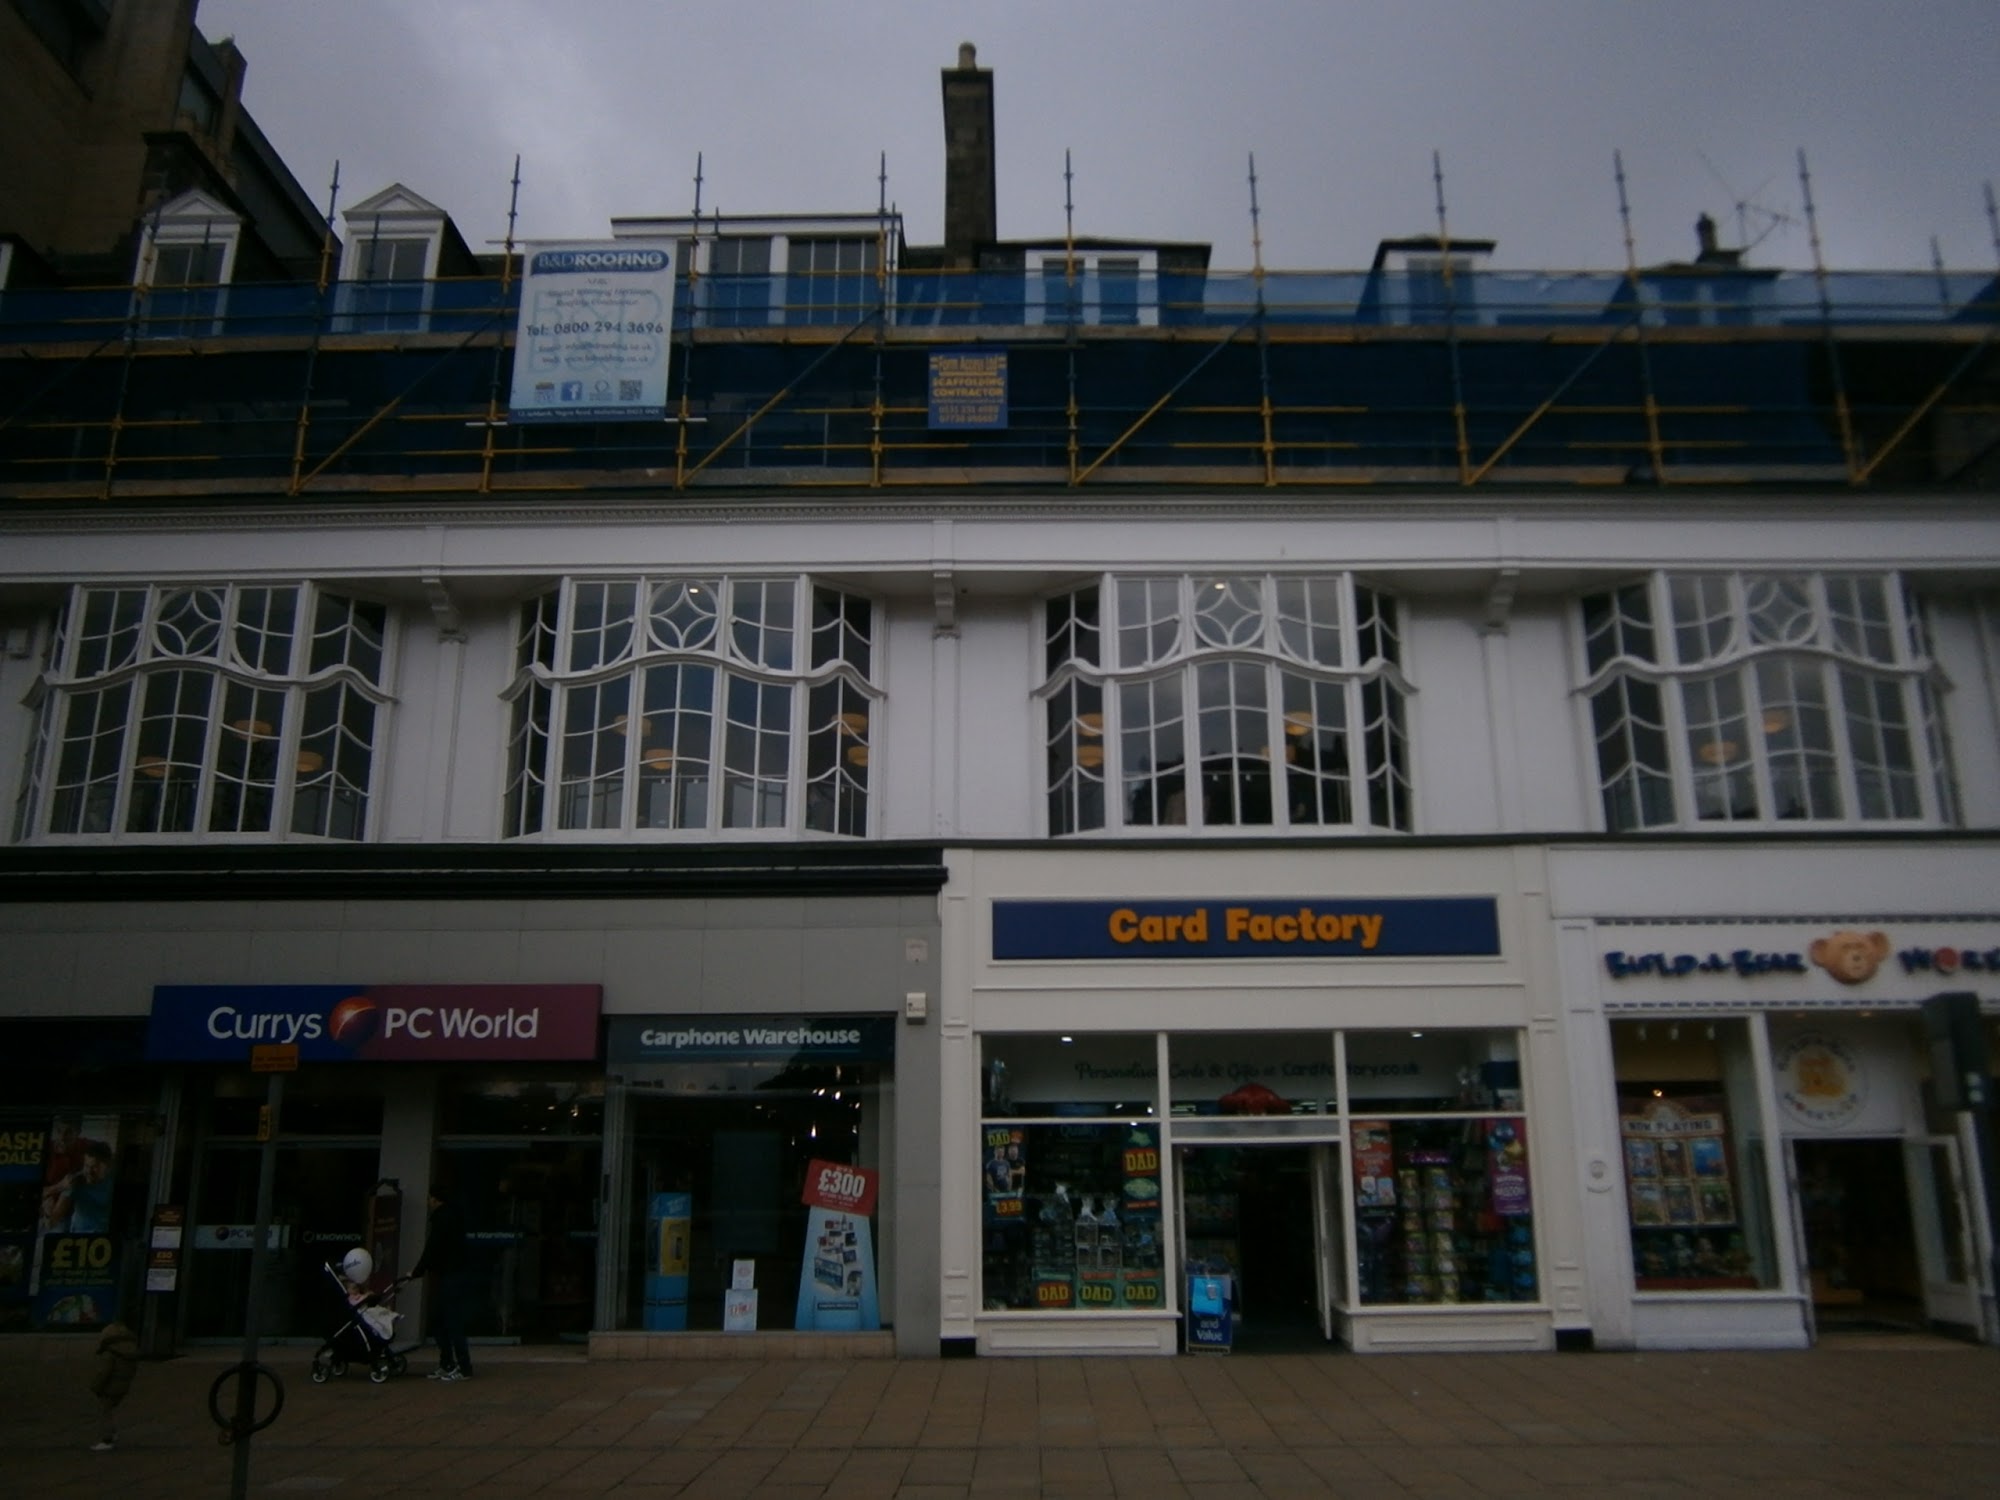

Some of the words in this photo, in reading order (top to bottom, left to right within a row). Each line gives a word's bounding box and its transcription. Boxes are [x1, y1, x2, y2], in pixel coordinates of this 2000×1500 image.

[554, 322, 590, 335] 0800
[594, 321, 621, 333] 294
[627, 322, 664, 334] 3696
[1108, 908, 1208, 943] Card
[1226, 908, 1383, 949] Factory
[207, 1006, 322, 1044] Currys
[384, 1007, 432, 1039] PC
[440, 1006, 539, 1039] World
[640, 1028, 739, 1049] Carphone
[743, 1027, 861, 1046] Warehouse
[1657, 1120, 1713, 1131] PLAYING
[988, 1131, 1011, 1147] DAD
[1124, 1151, 1158, 1172] DAD
[817, 1168, 867, 1198] £300
[51, 1237, 112, 1268] £10
[1039, 1285, 1069, 1302] DAD
[1081, 1285, 1113, 1302] DAD
[1126, 1285, 1157, 1301] DAD
[1196, 1328, 1223, 1342] Value
